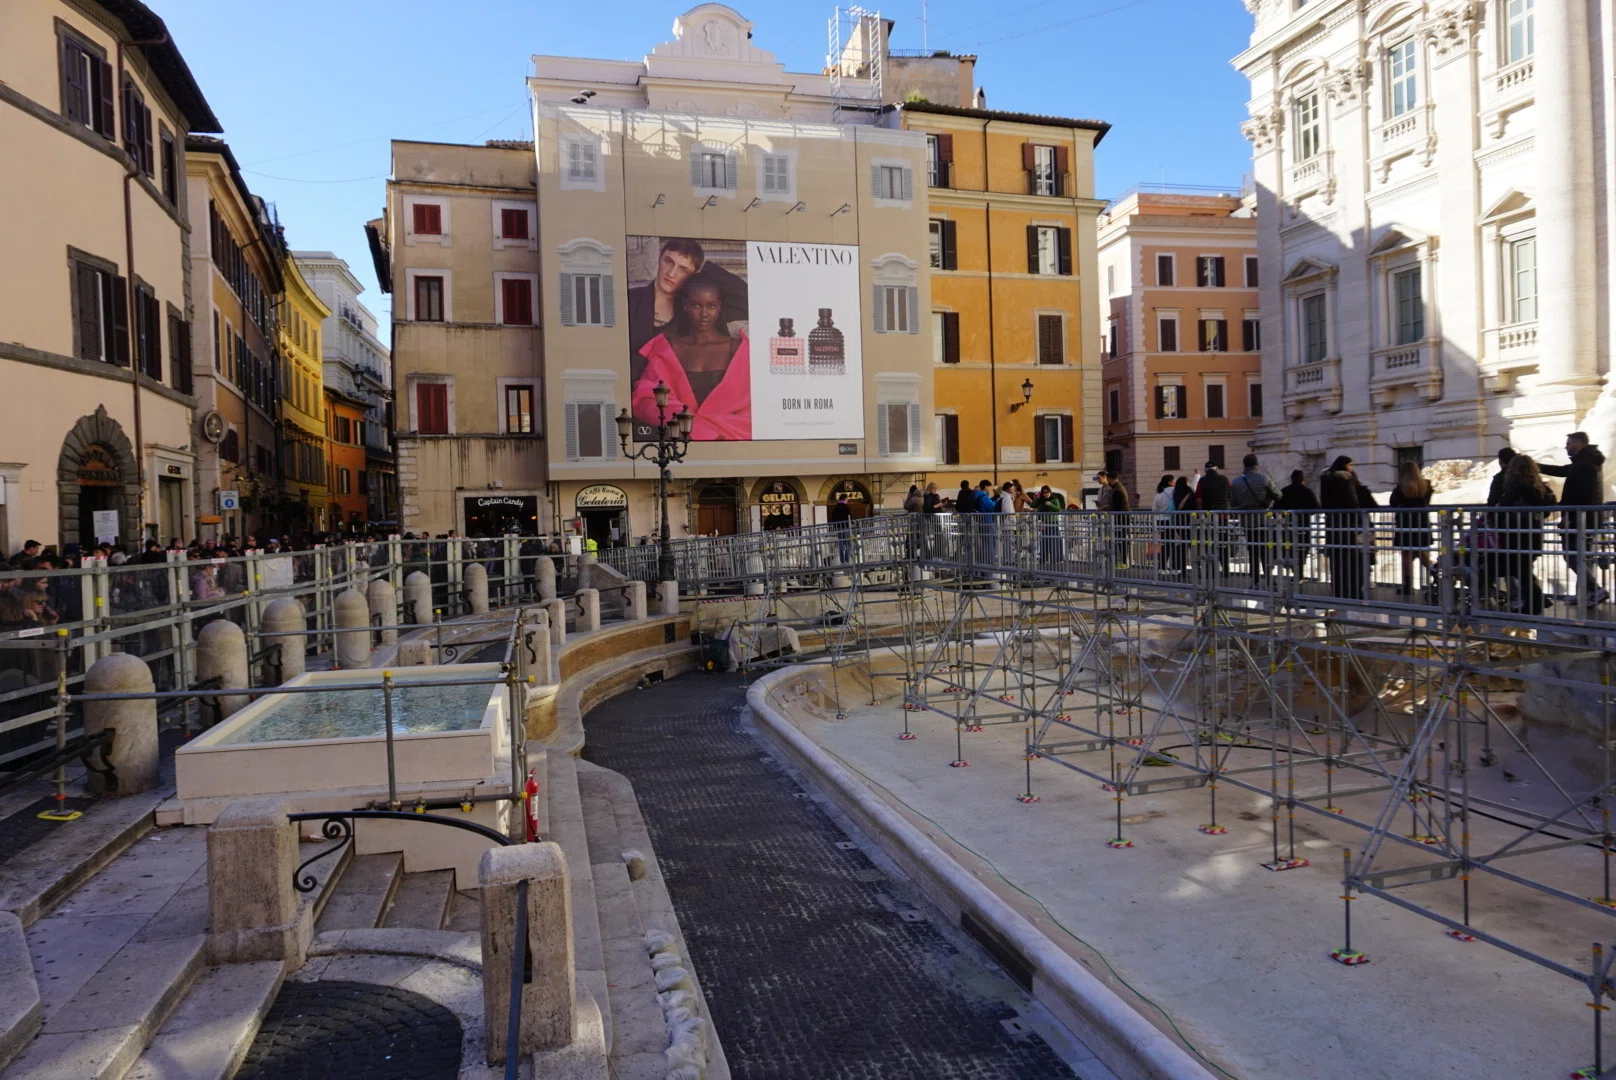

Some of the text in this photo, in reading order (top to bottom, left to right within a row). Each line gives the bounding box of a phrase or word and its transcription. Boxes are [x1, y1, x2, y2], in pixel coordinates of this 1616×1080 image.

[756, 245, 852, 266] VALENTINO
[782, 398, 834, 410] BORN IN ROMA
[602, 487, 620, 496] Roma
[834, 491, 864, 500] PZZA
[578, 496, 624, 505] Gelateria
[762, 493, 795, 502] GELATI
[477, 497, 524, 508] Captain Candy
